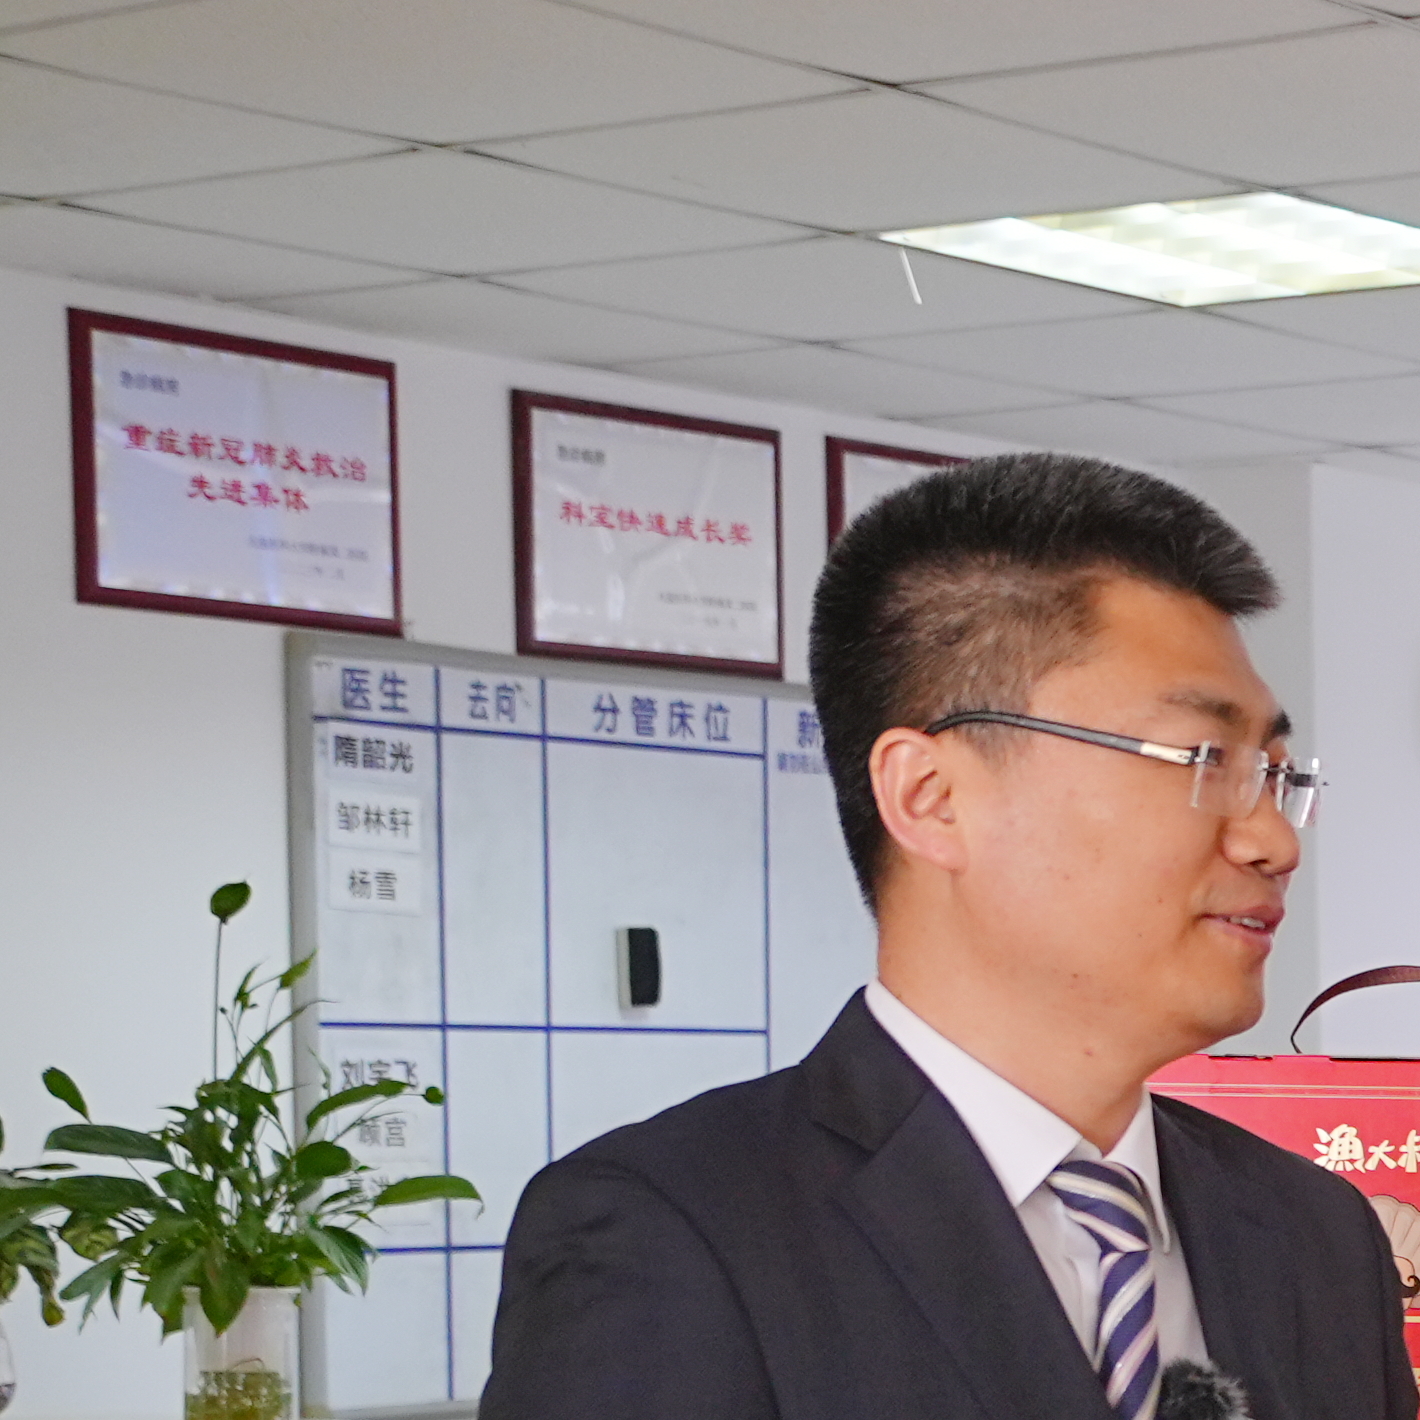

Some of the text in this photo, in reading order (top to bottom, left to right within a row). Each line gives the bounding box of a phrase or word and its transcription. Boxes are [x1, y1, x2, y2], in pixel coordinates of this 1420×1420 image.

[122, 424, 368, 482] 重症新冠肺炎救治
[187, 475, 309, 511] 先进集体
[560, 501, 752, 546] 科室快速成长奖
[341, 667, 409, 713] 医生
[468, 680, 517, 724] 去向
[594, 692, 731, 742] 分管床位
[349, 868, 397, 901] 杨雪
